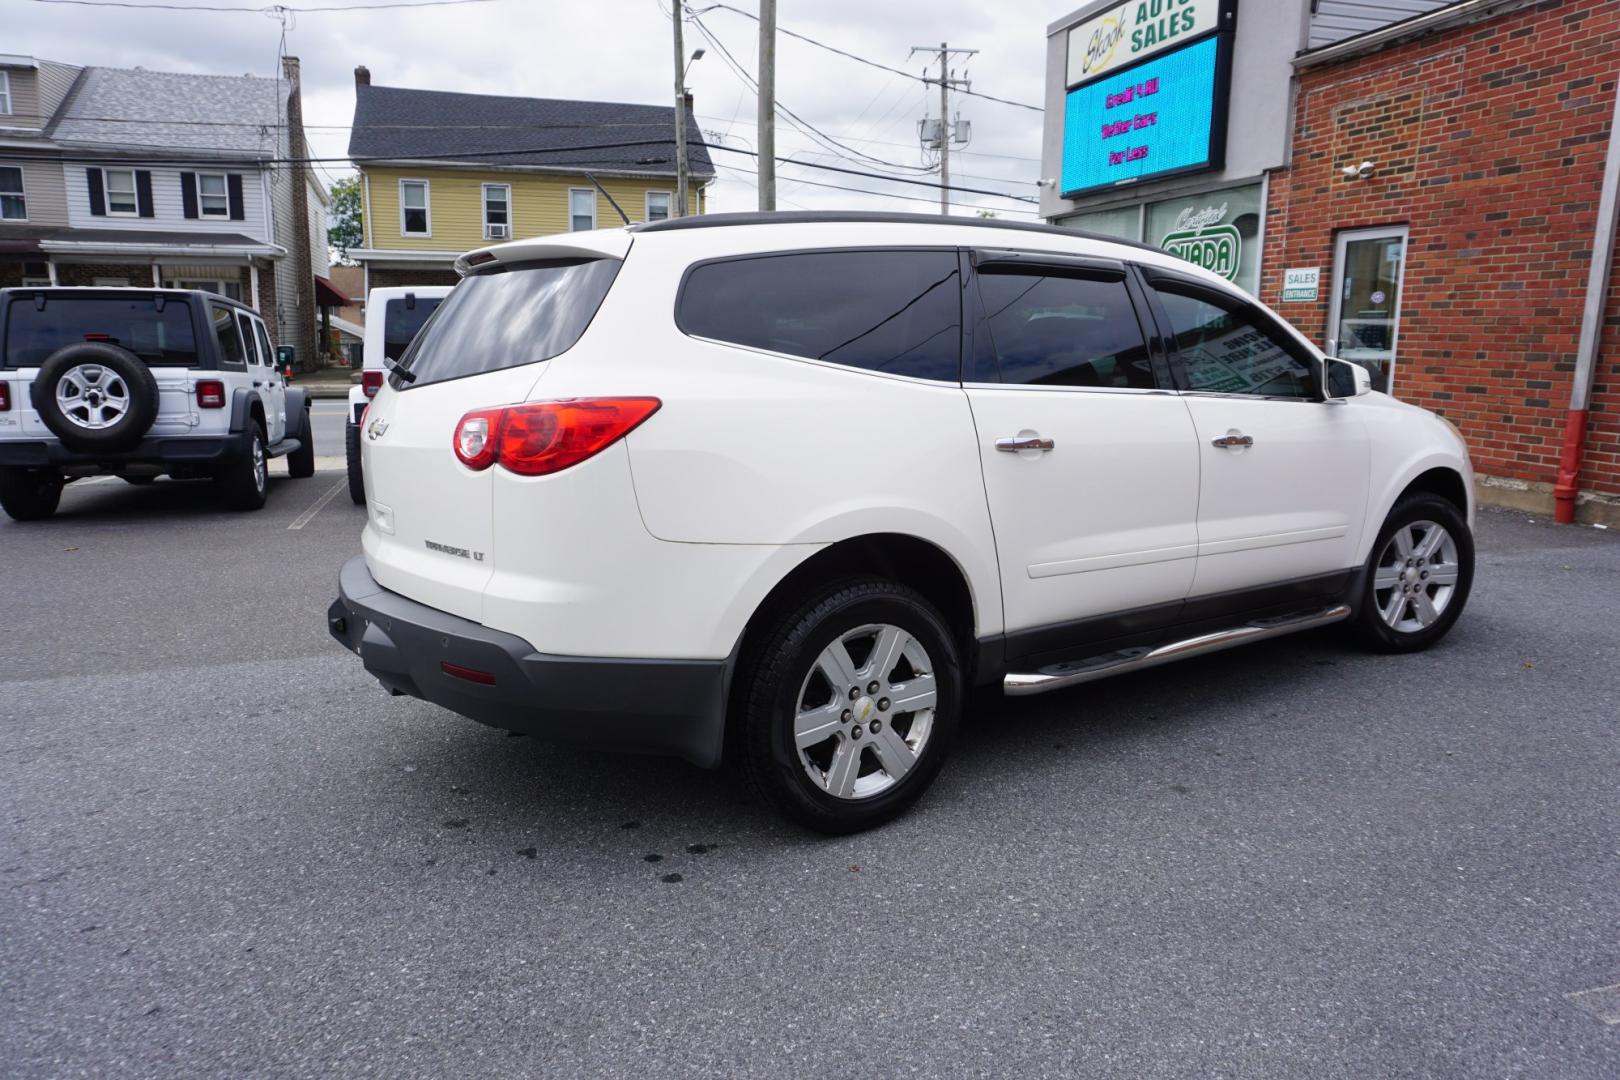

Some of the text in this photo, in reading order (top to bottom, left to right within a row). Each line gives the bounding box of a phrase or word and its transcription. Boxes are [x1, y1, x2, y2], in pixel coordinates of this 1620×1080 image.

[1131, 6, 1195, 53] SALES
[1288, 273, 1316, 284] SALES
[1285, 290, 1316, 299] ENTRANCE
[473, 551, 485, 561] LT
